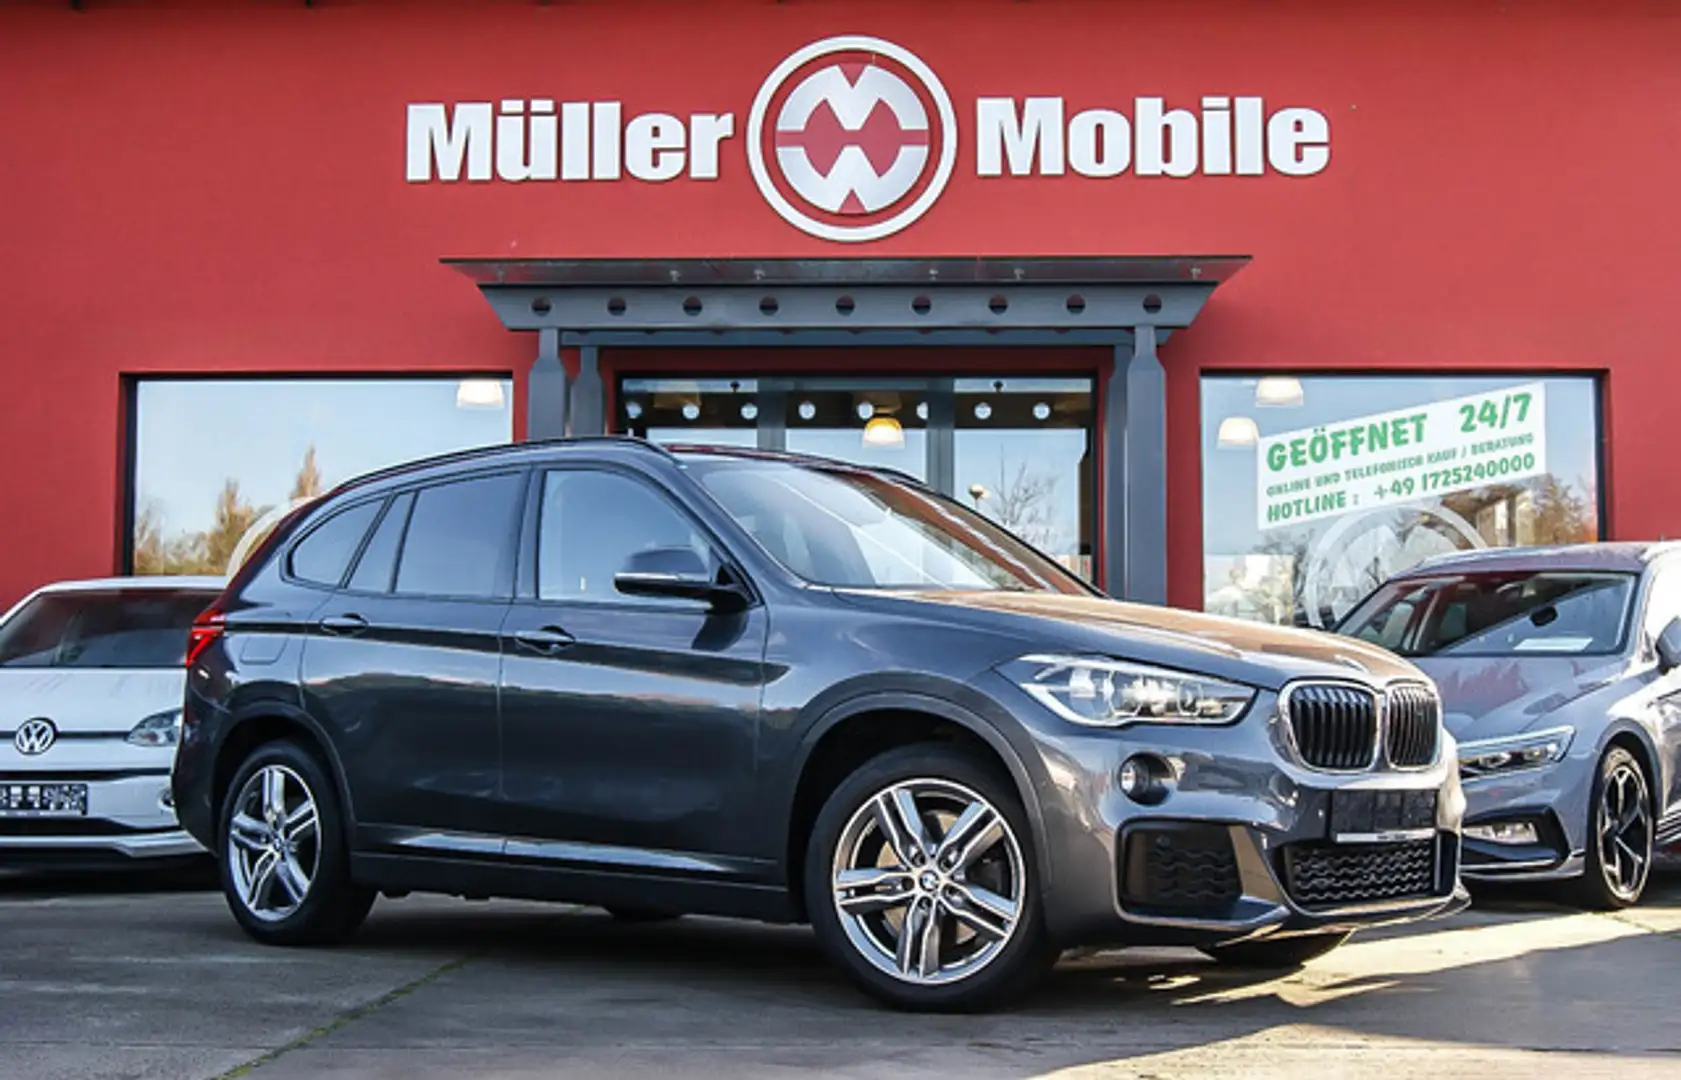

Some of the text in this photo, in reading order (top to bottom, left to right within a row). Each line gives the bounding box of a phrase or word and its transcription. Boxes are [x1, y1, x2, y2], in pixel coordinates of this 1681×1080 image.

[406, 96, 1330, 182] Müller Mobile
[1266, 392, 1533, 471] GEÖFFNET 24/7
[1266, 478, 1311, 497] ONLINE
[1315, 472, 1341, 487] UND
[1344, 455, 1424, 481] TELEFONISCH
[1426, 447, 1457, 464] KAUF
[1471, 432, 1534, 456] BERATUNG
[1267, 490, 1347, 522] HOTLINE
[1373, 476, 1415, 499] +49
[1421, 452, 1535, 491] 1725240000
